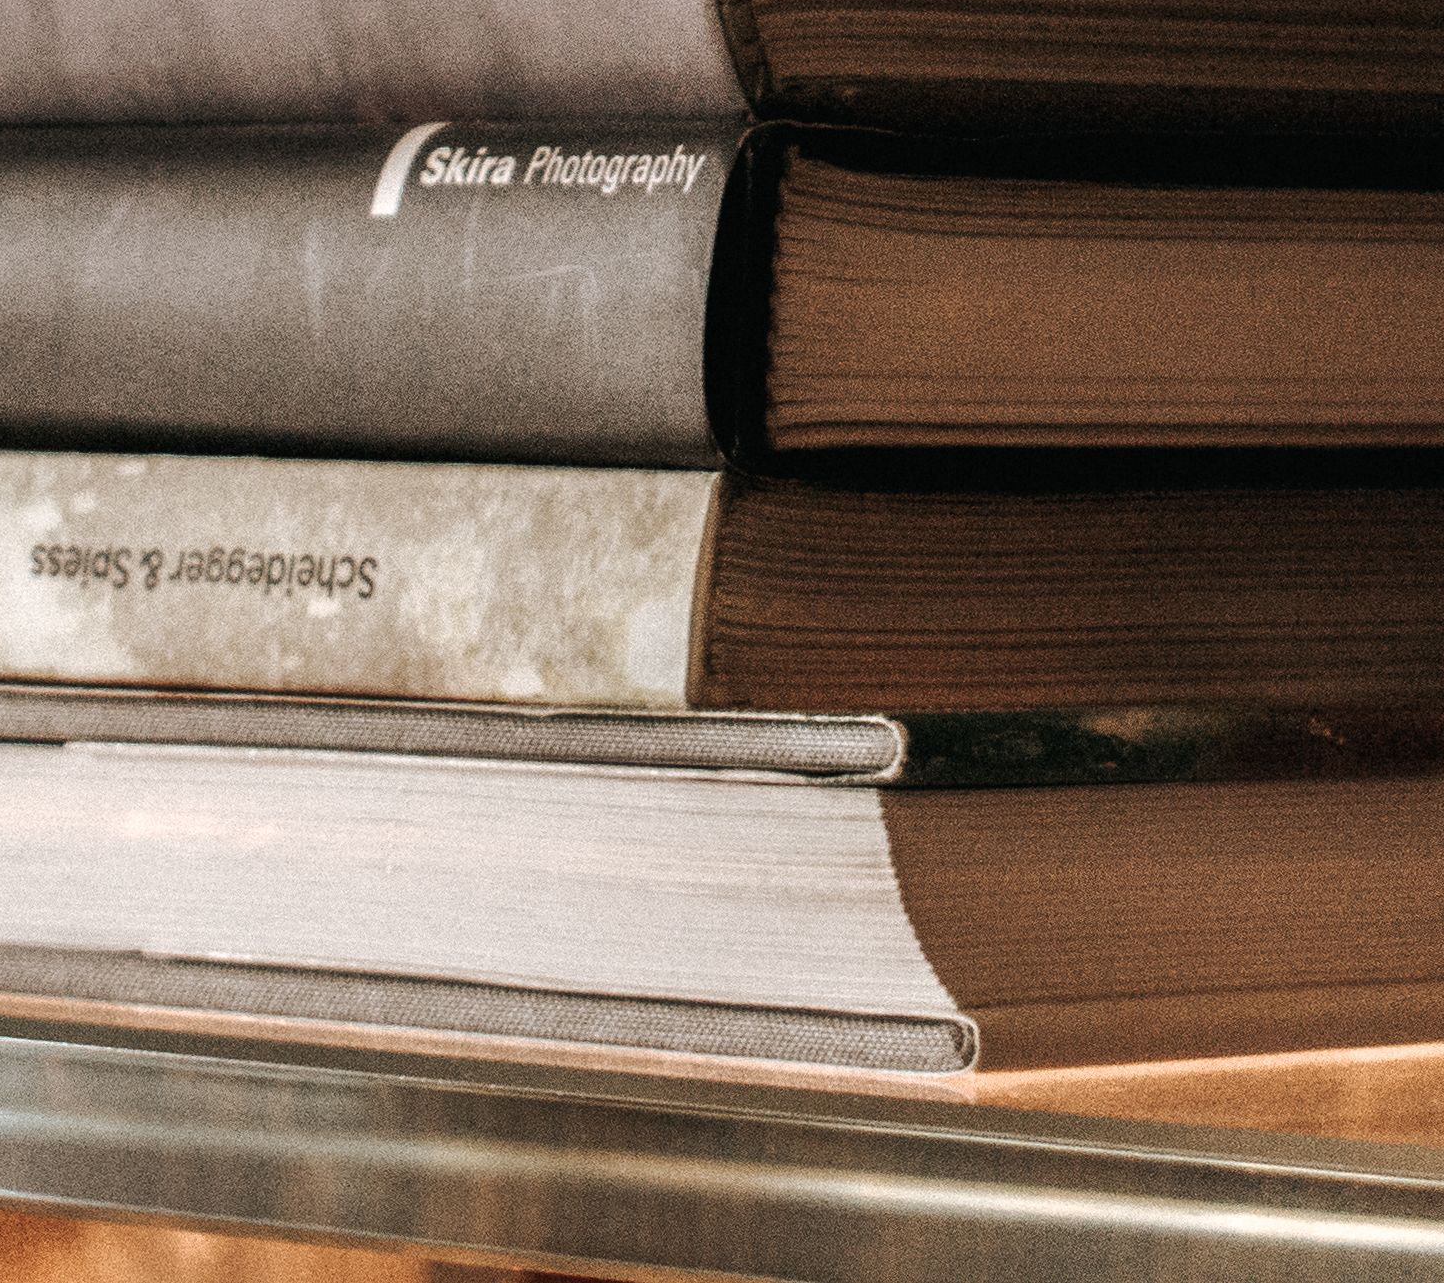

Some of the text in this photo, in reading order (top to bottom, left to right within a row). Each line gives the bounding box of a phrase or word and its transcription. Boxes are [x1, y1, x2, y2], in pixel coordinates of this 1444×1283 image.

[418, 143, 707, 195] Skira Photography
[30, 543, 379, 599] Scheidegger & Spiess
